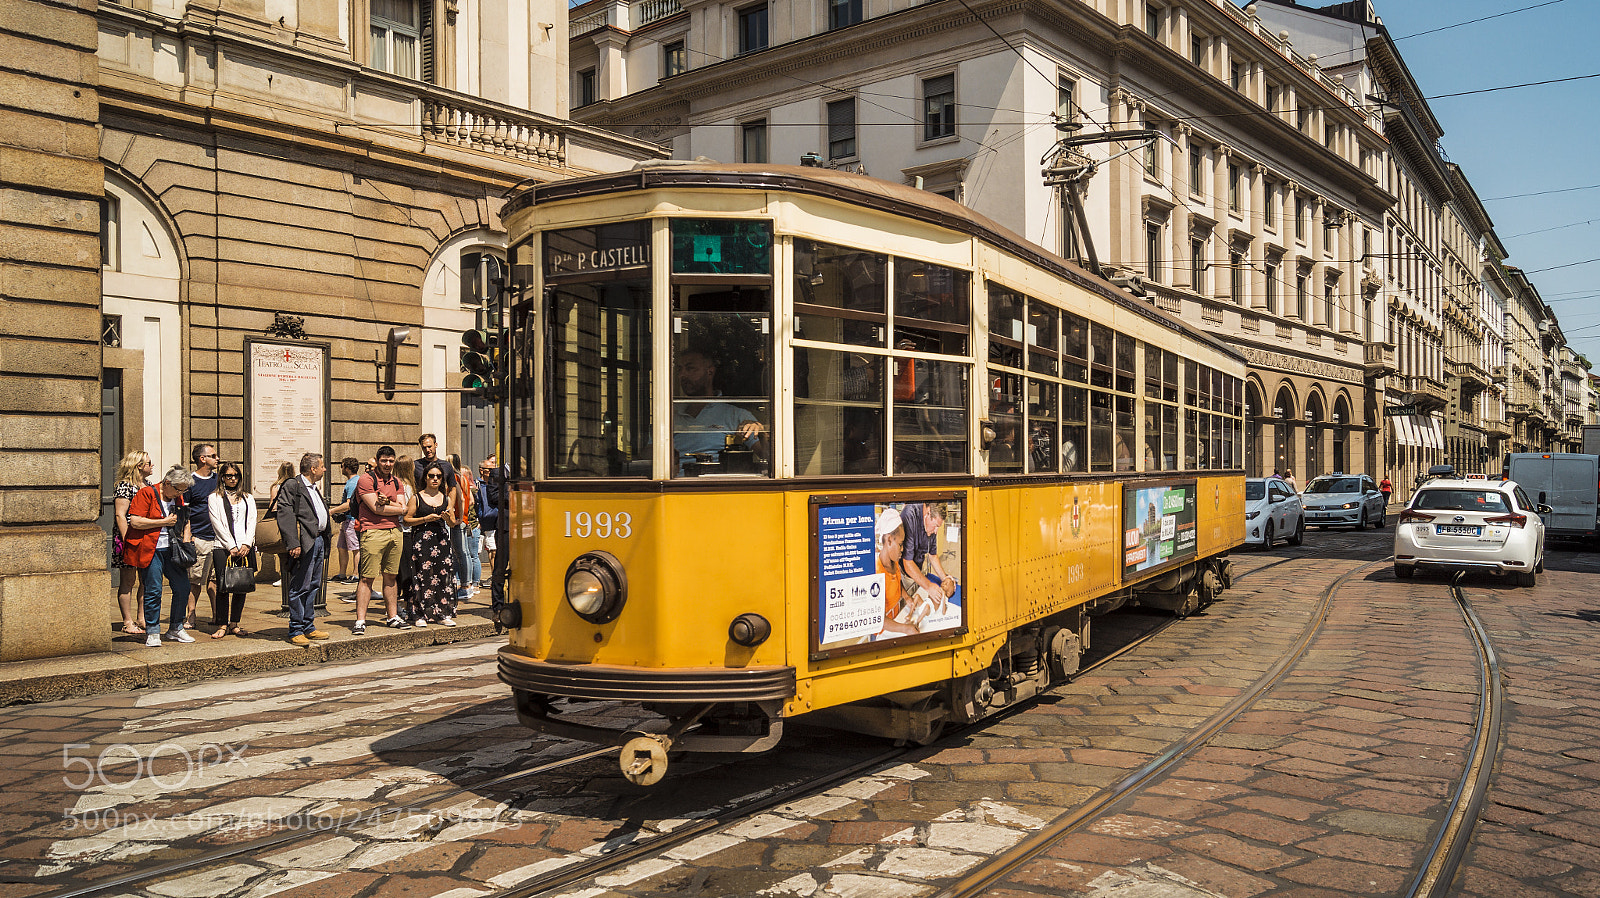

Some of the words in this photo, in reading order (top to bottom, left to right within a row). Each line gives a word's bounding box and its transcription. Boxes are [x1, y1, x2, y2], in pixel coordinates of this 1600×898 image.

[591, 244, 650, 268] CASTELLI
[294, 361, 318, 371] SCALA
[564, 511, 632, 538] 1993
[823, 517, 844, 525] Firma
[846, 517, 857, 525] per
[1067, 563, 1084, 584] 1993
[830, 588, 844, 599] 5x
[829, 601, 845, 609] mille
[830, 611, 854, 621] codice
[857, 605, 881, 617] fiscale
[829, 615, 881, 632] 97264070158
